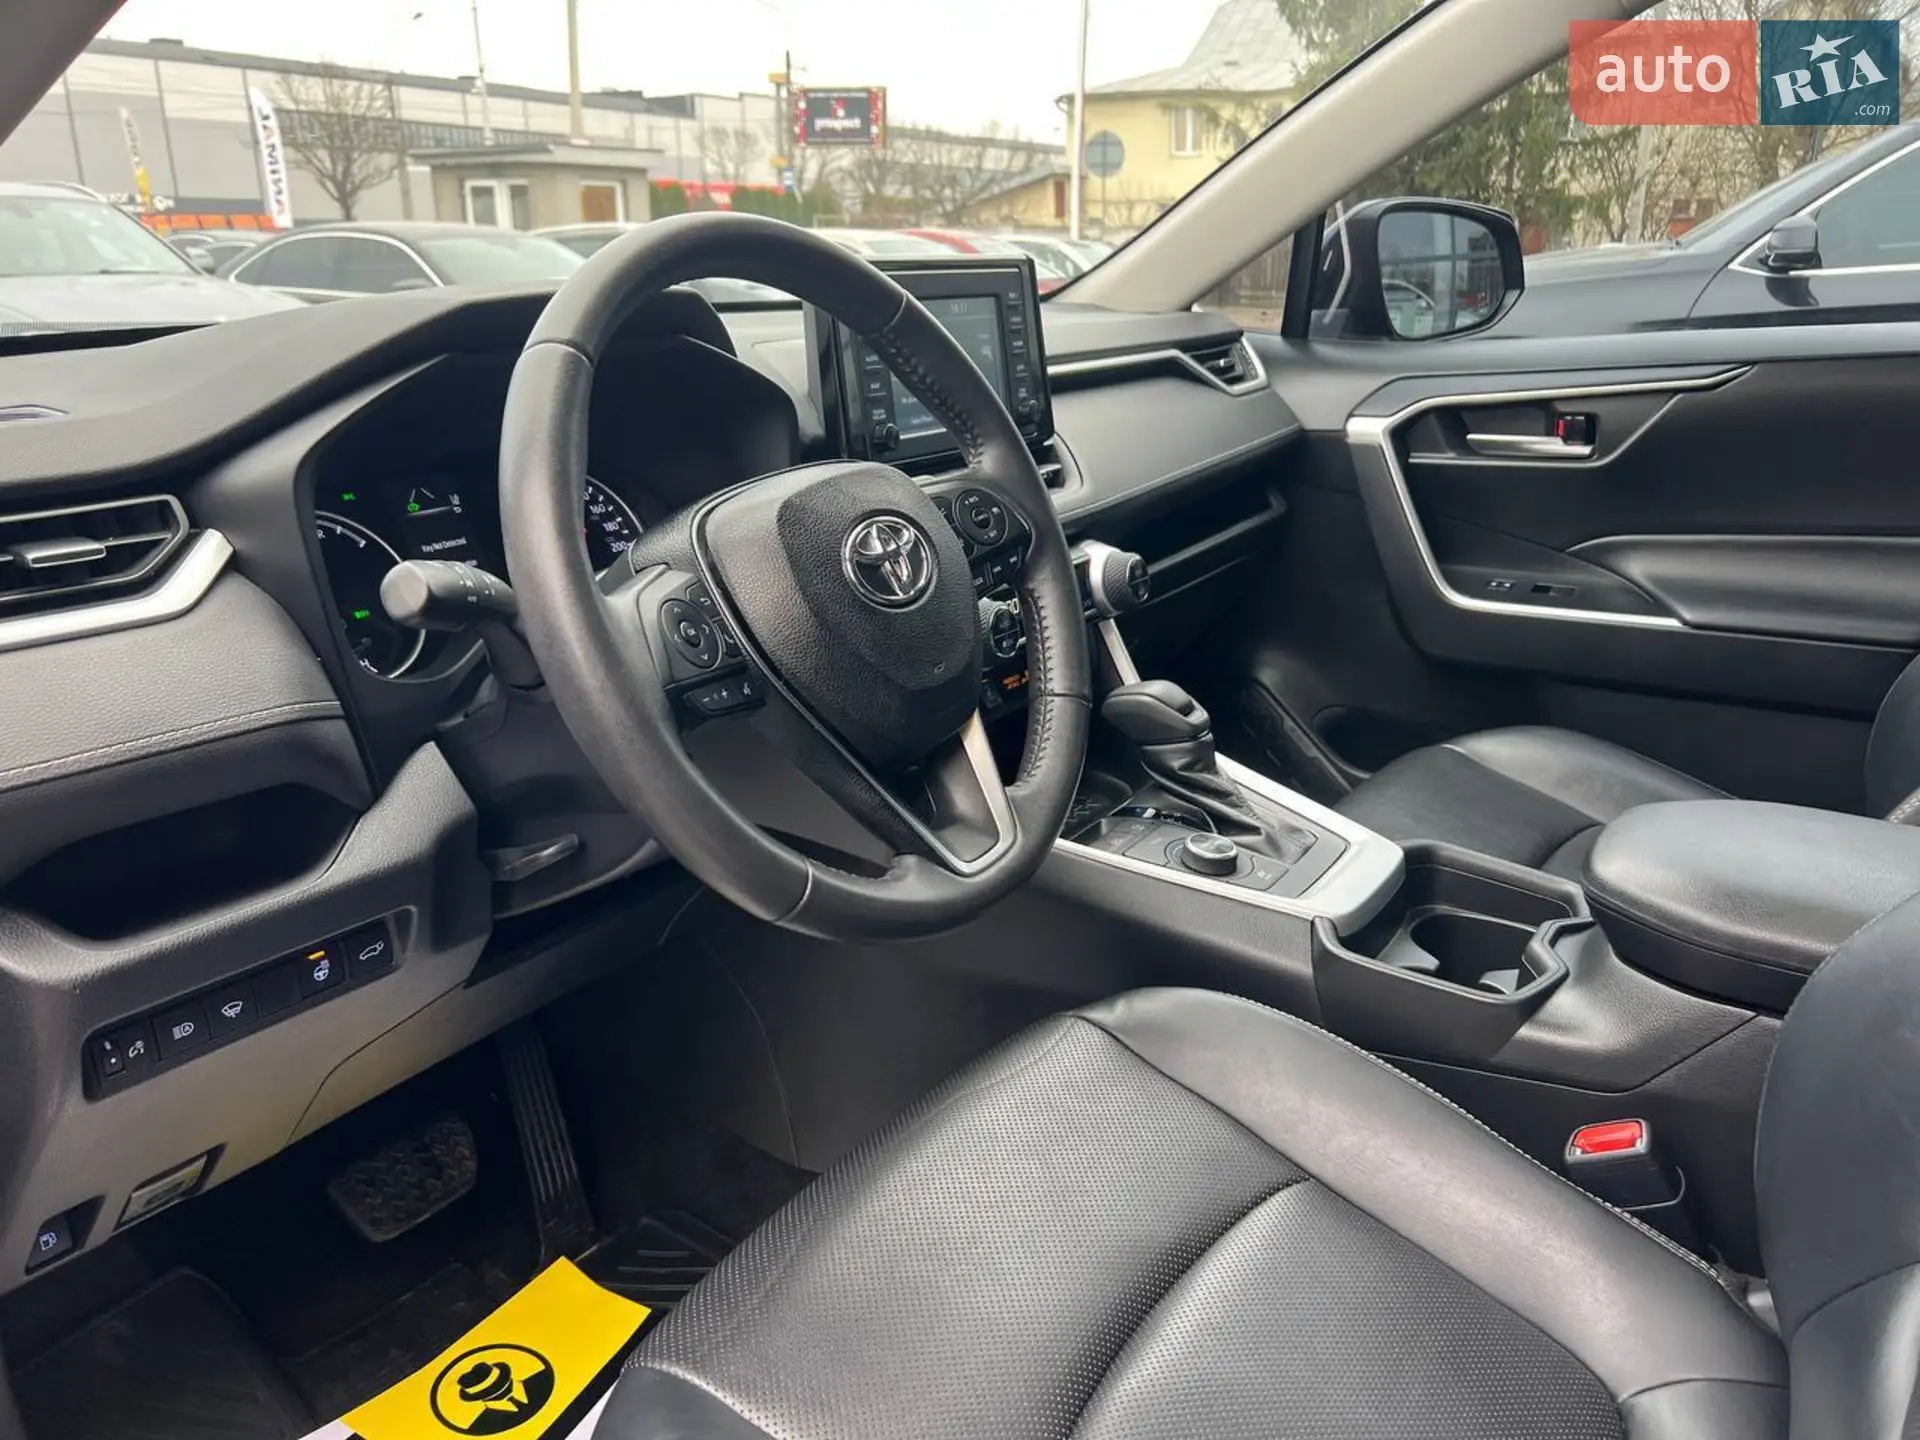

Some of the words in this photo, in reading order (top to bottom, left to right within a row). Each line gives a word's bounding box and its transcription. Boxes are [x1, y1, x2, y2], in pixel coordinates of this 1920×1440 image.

[589, 503, 606, 514] 160
[602, 521, 620, 532] 180
[610, 541, 629, 553] 200
